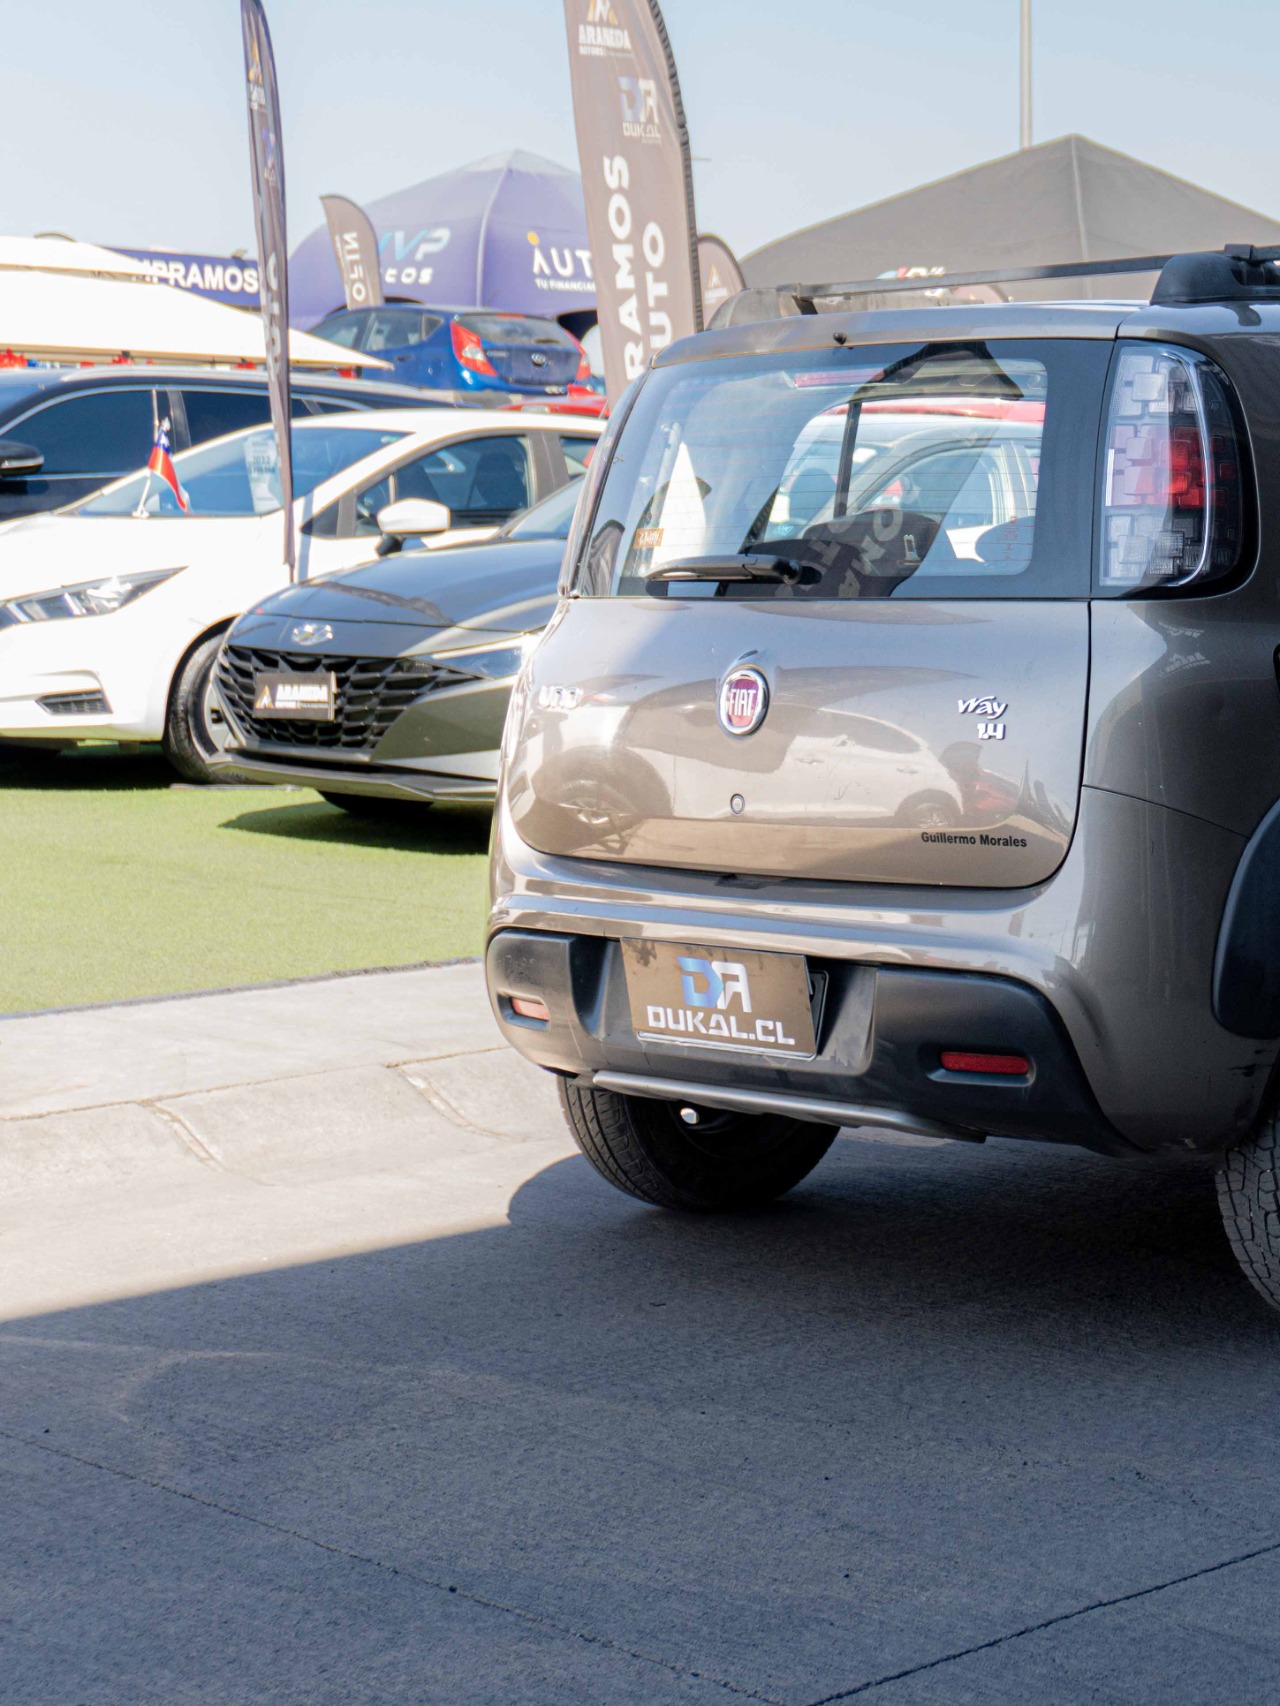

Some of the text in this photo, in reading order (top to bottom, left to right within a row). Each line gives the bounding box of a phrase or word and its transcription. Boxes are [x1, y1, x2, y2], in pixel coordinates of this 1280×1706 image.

[578, 24, 632, 51] ARANEDA
[622, 122, 662, 138] DUKAL
[727, 688, 756, 717] FIAT
[957, 695, 1010, 720] Way
[977, 722, 1006, 741] 1.4
[920, 831, 1029, 849] Guillermo Morales
[646, 1005, 796, 1046] DUKAL.CL
